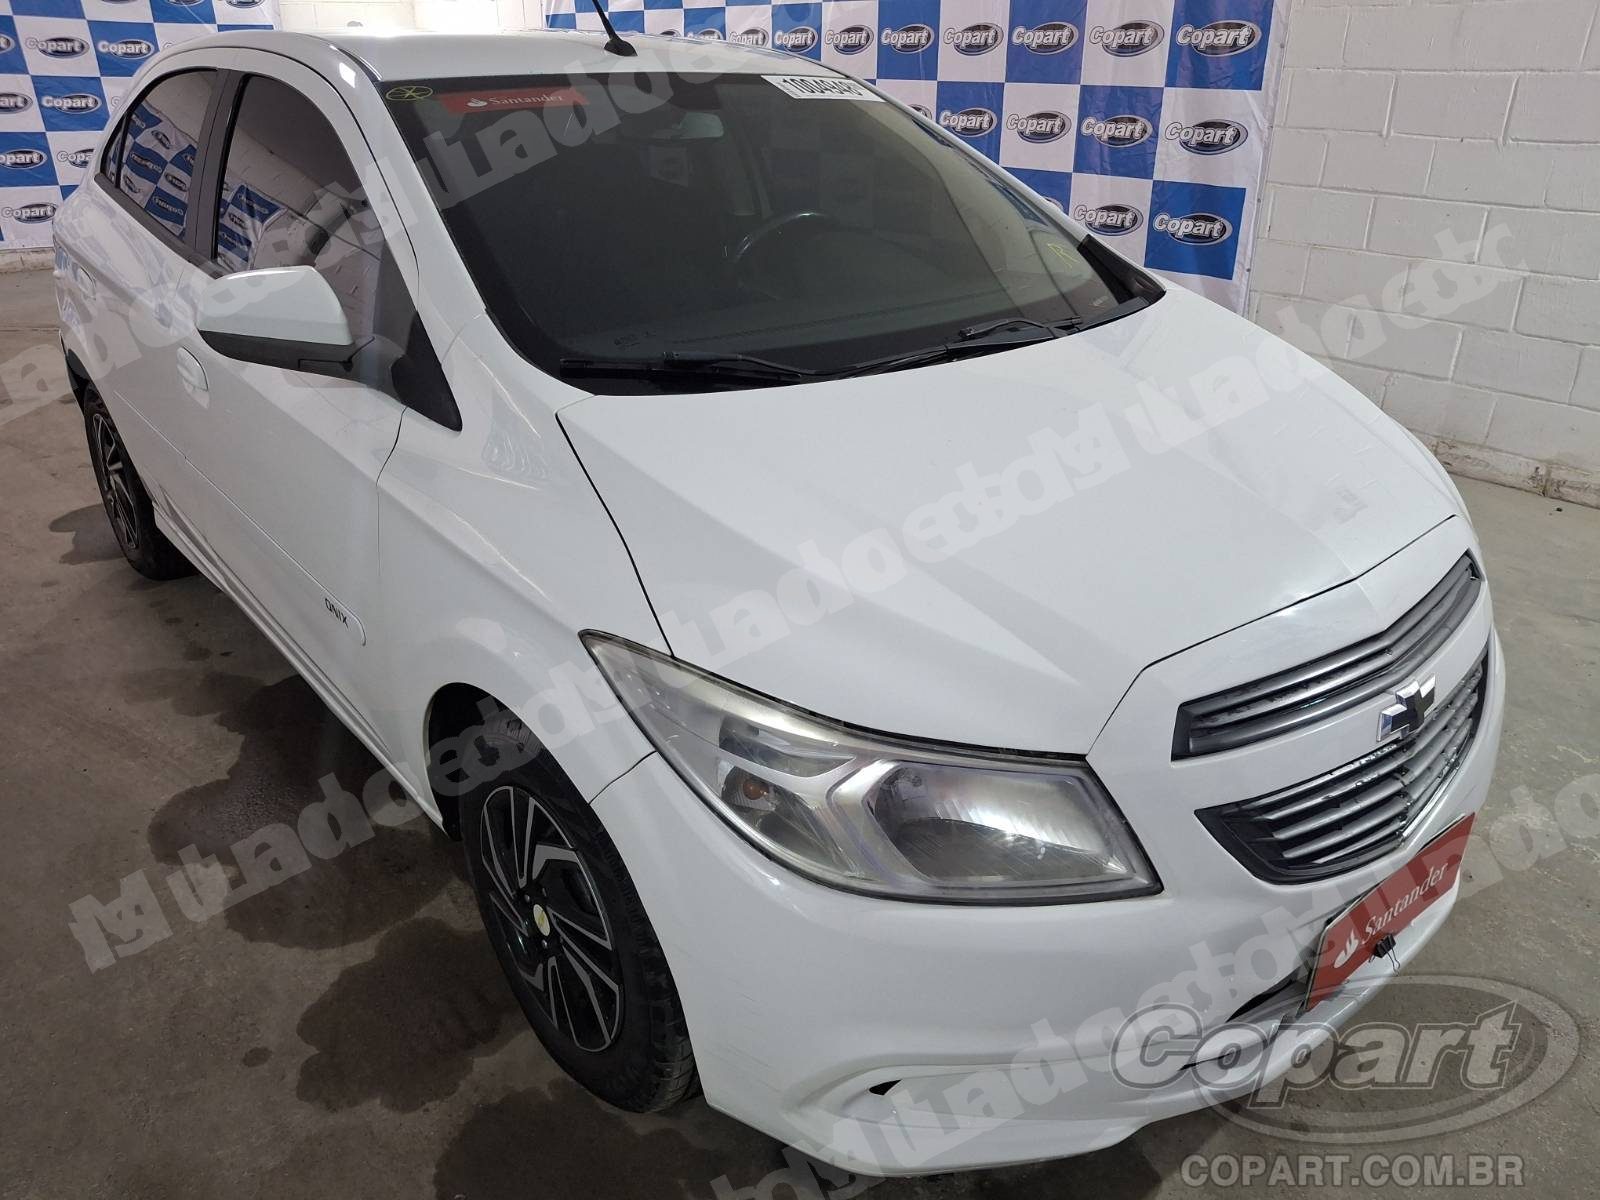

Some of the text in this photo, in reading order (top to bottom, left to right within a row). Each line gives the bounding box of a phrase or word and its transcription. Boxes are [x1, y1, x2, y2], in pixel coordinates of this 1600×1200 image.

[25, 37, 80, 53] Copart
[774, 31, 813, 47] Copart
[824, 30, 869, 48] Copart
[881, 26, 928, 48] Copart
[944, 24, 997, 48] Copart
[1012, 25, 1070, 48] Copart
[1089, 24, 1153, 49] Copart
[1176, 21, 1251, 49] Copart
[98, 40, 148, 56] Copart
[41, 95, 97, 110] Copart
[489, 91, 566, 106] Santander
[939, 110, 991, 131] Copart
[1006, 114, 1064, 136] Copart
[1081, 117, 1147, 146] Copart
[1165, 121, 1237, 149] Copart
[0, 151, 41, 166] opart
[1, 203, 55, 220] Copart
[1074, 204, 1136, 231] Copart
[1153, 213, 1224, 239] Copart
[324, 597, 349, 629] ONIX
[1362, 861, 1449, 946] Santander
